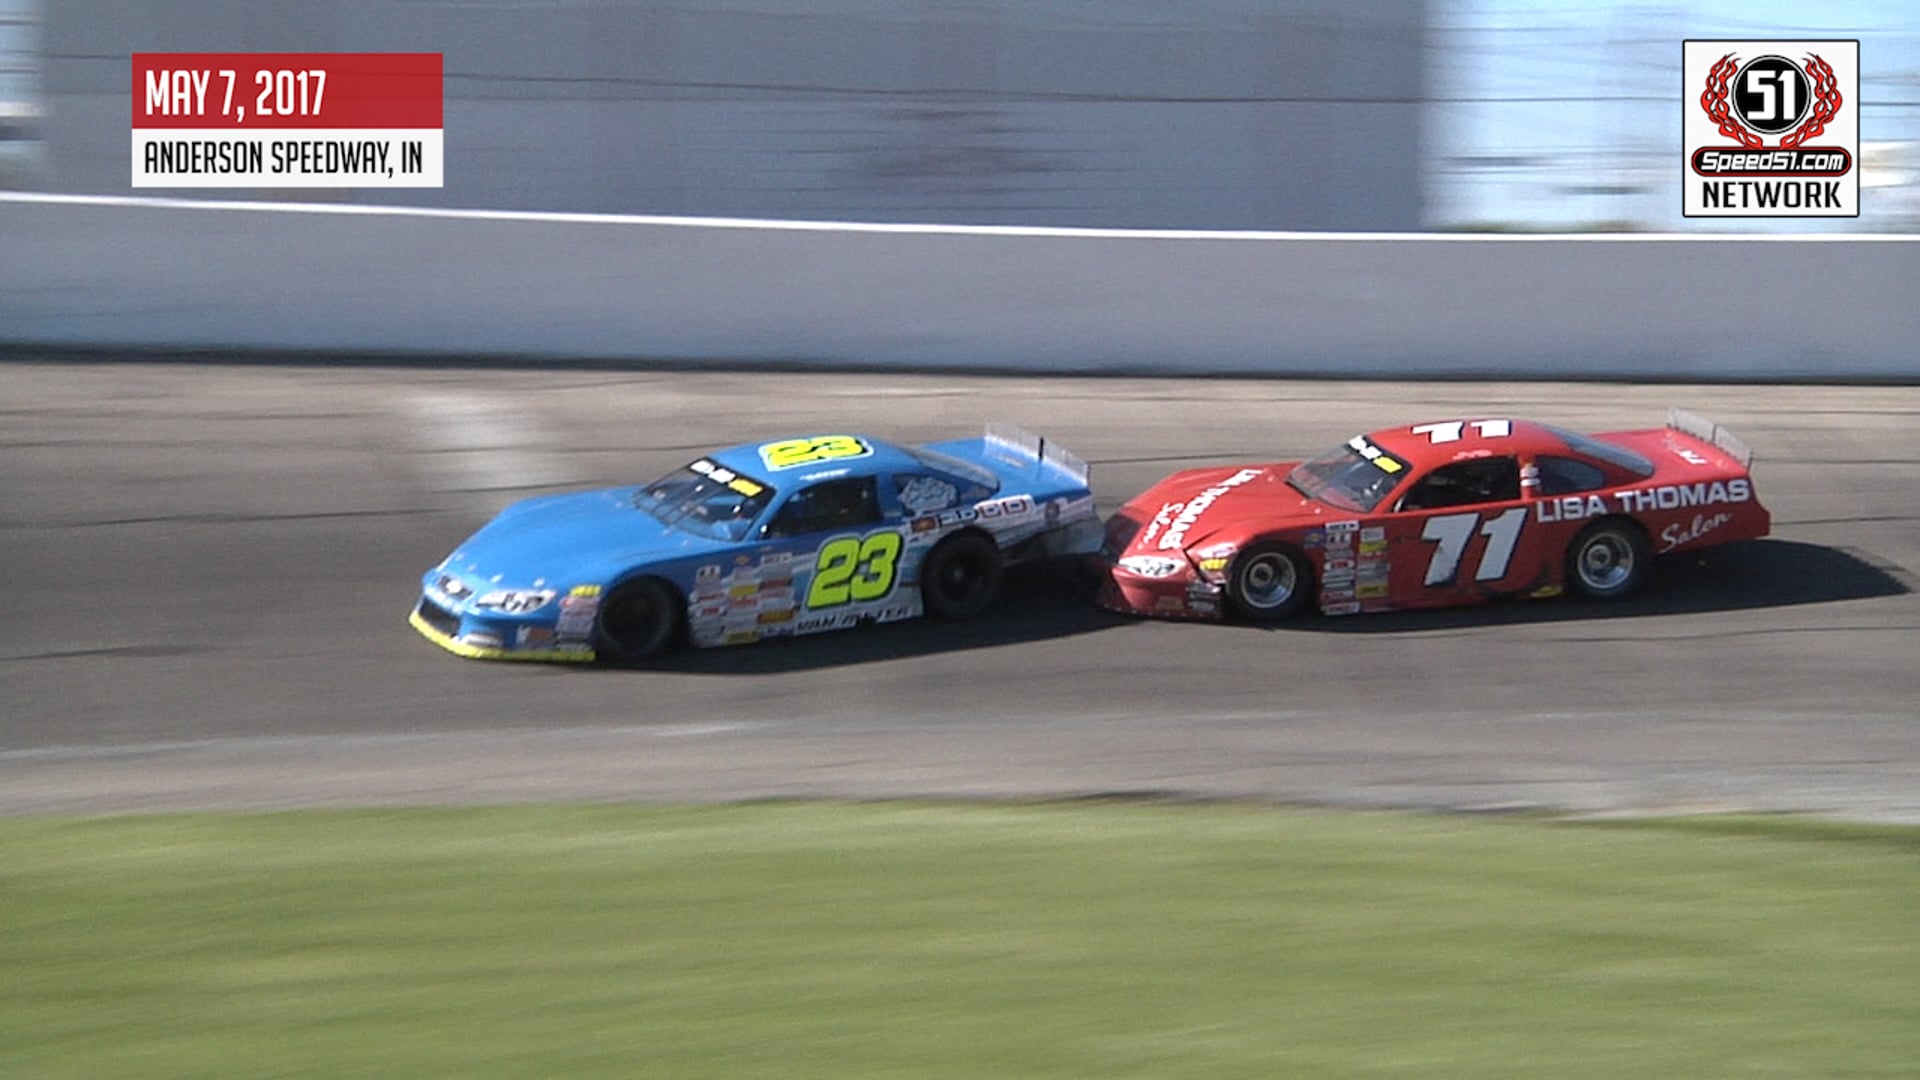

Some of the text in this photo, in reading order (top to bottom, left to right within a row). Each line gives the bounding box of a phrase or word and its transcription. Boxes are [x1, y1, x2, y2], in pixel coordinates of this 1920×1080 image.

[766, 434, 866, 467] 23
[1411, 418, 1512, 445] 71
[1536, 478, 1751, 523] LISA THOMAS
[1420, 507, 1530, 587] 71
[1658, 512, 1730, 553] Salon
[806, 531, 903, 609] 23
